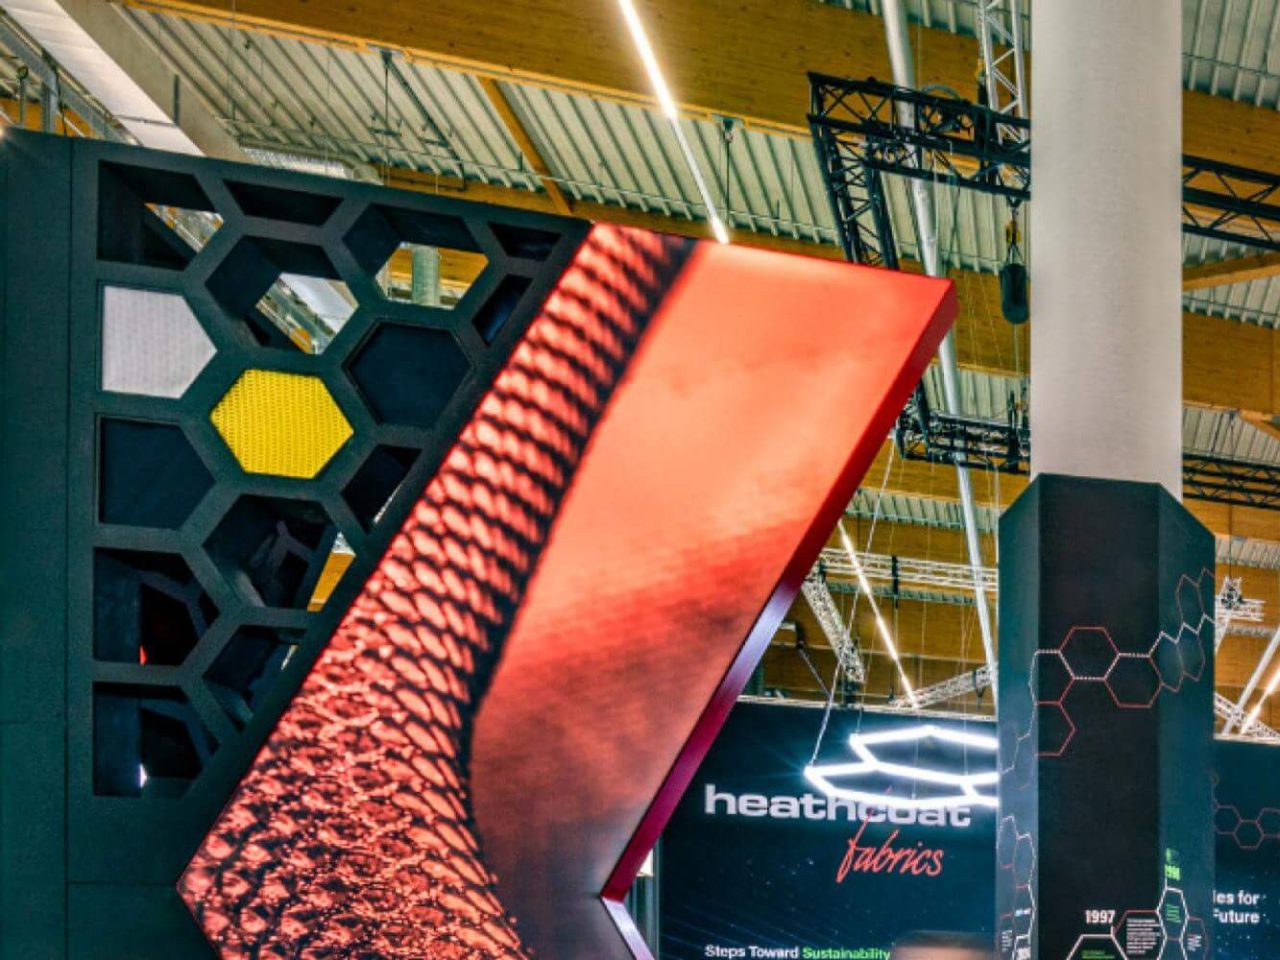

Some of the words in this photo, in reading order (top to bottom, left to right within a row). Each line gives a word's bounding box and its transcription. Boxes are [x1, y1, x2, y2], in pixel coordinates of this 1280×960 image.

[704, 783, 972, 828] heathcoat
[835, 795, 945, 884] fabrics
[1238, 889, 1261, 905] for
[1085, 909, 1116, 924] 1997
[704, 944, 746, 960] Steps
[749, 945, 800, 959] Toward
